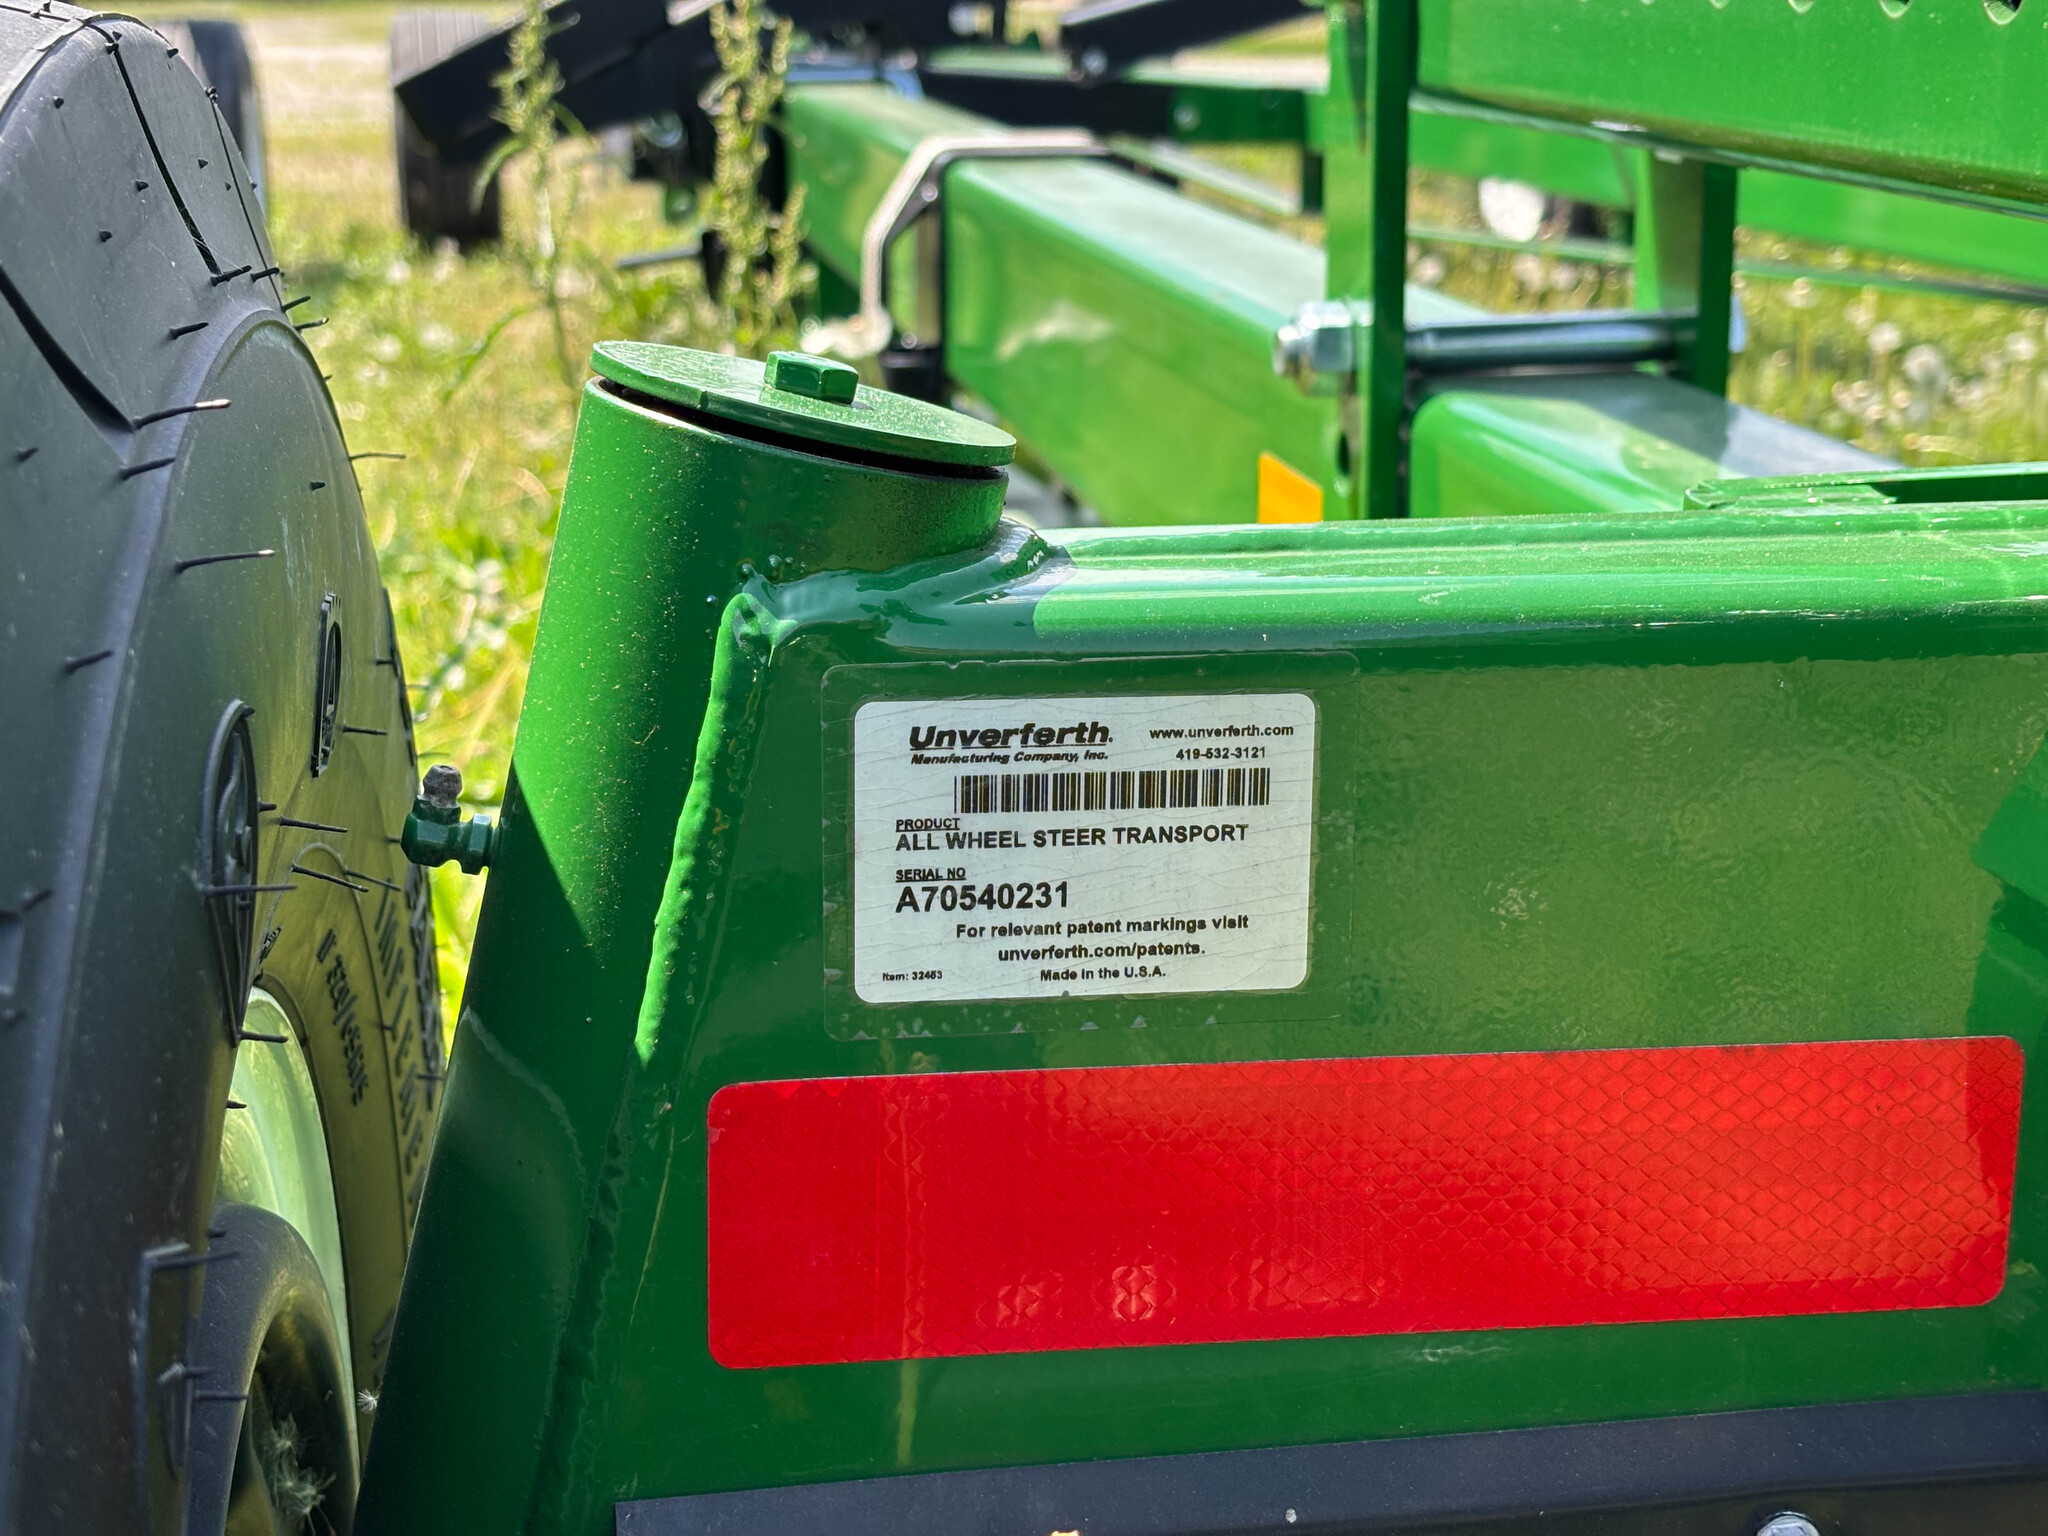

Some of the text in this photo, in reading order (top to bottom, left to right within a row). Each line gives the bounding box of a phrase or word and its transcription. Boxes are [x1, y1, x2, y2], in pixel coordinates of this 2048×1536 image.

[1149, 724, 1293, 739] www.unverferth.com
[910, 750, 1108, 765] Manufacturing Company, Inc.
[1176, 747, 1265, 760] 419-532-3121
[896, 818, 960, 829] PRODUCT
[896, 824, 1249, 851] ALL WHEEL STEER TRANSPORT
[896, 867, 966, 880] SERIAL NO
[895, 880, 1067, 913] A70540231
[957, 915, 1248, 938] For relevant patent markings visit
[998, 941, 1205, 961] unverferth.com/patents.
[883, 973, 908, 981] Item:
[1041, 966, 1166, 981] Made in the U.S.A.
